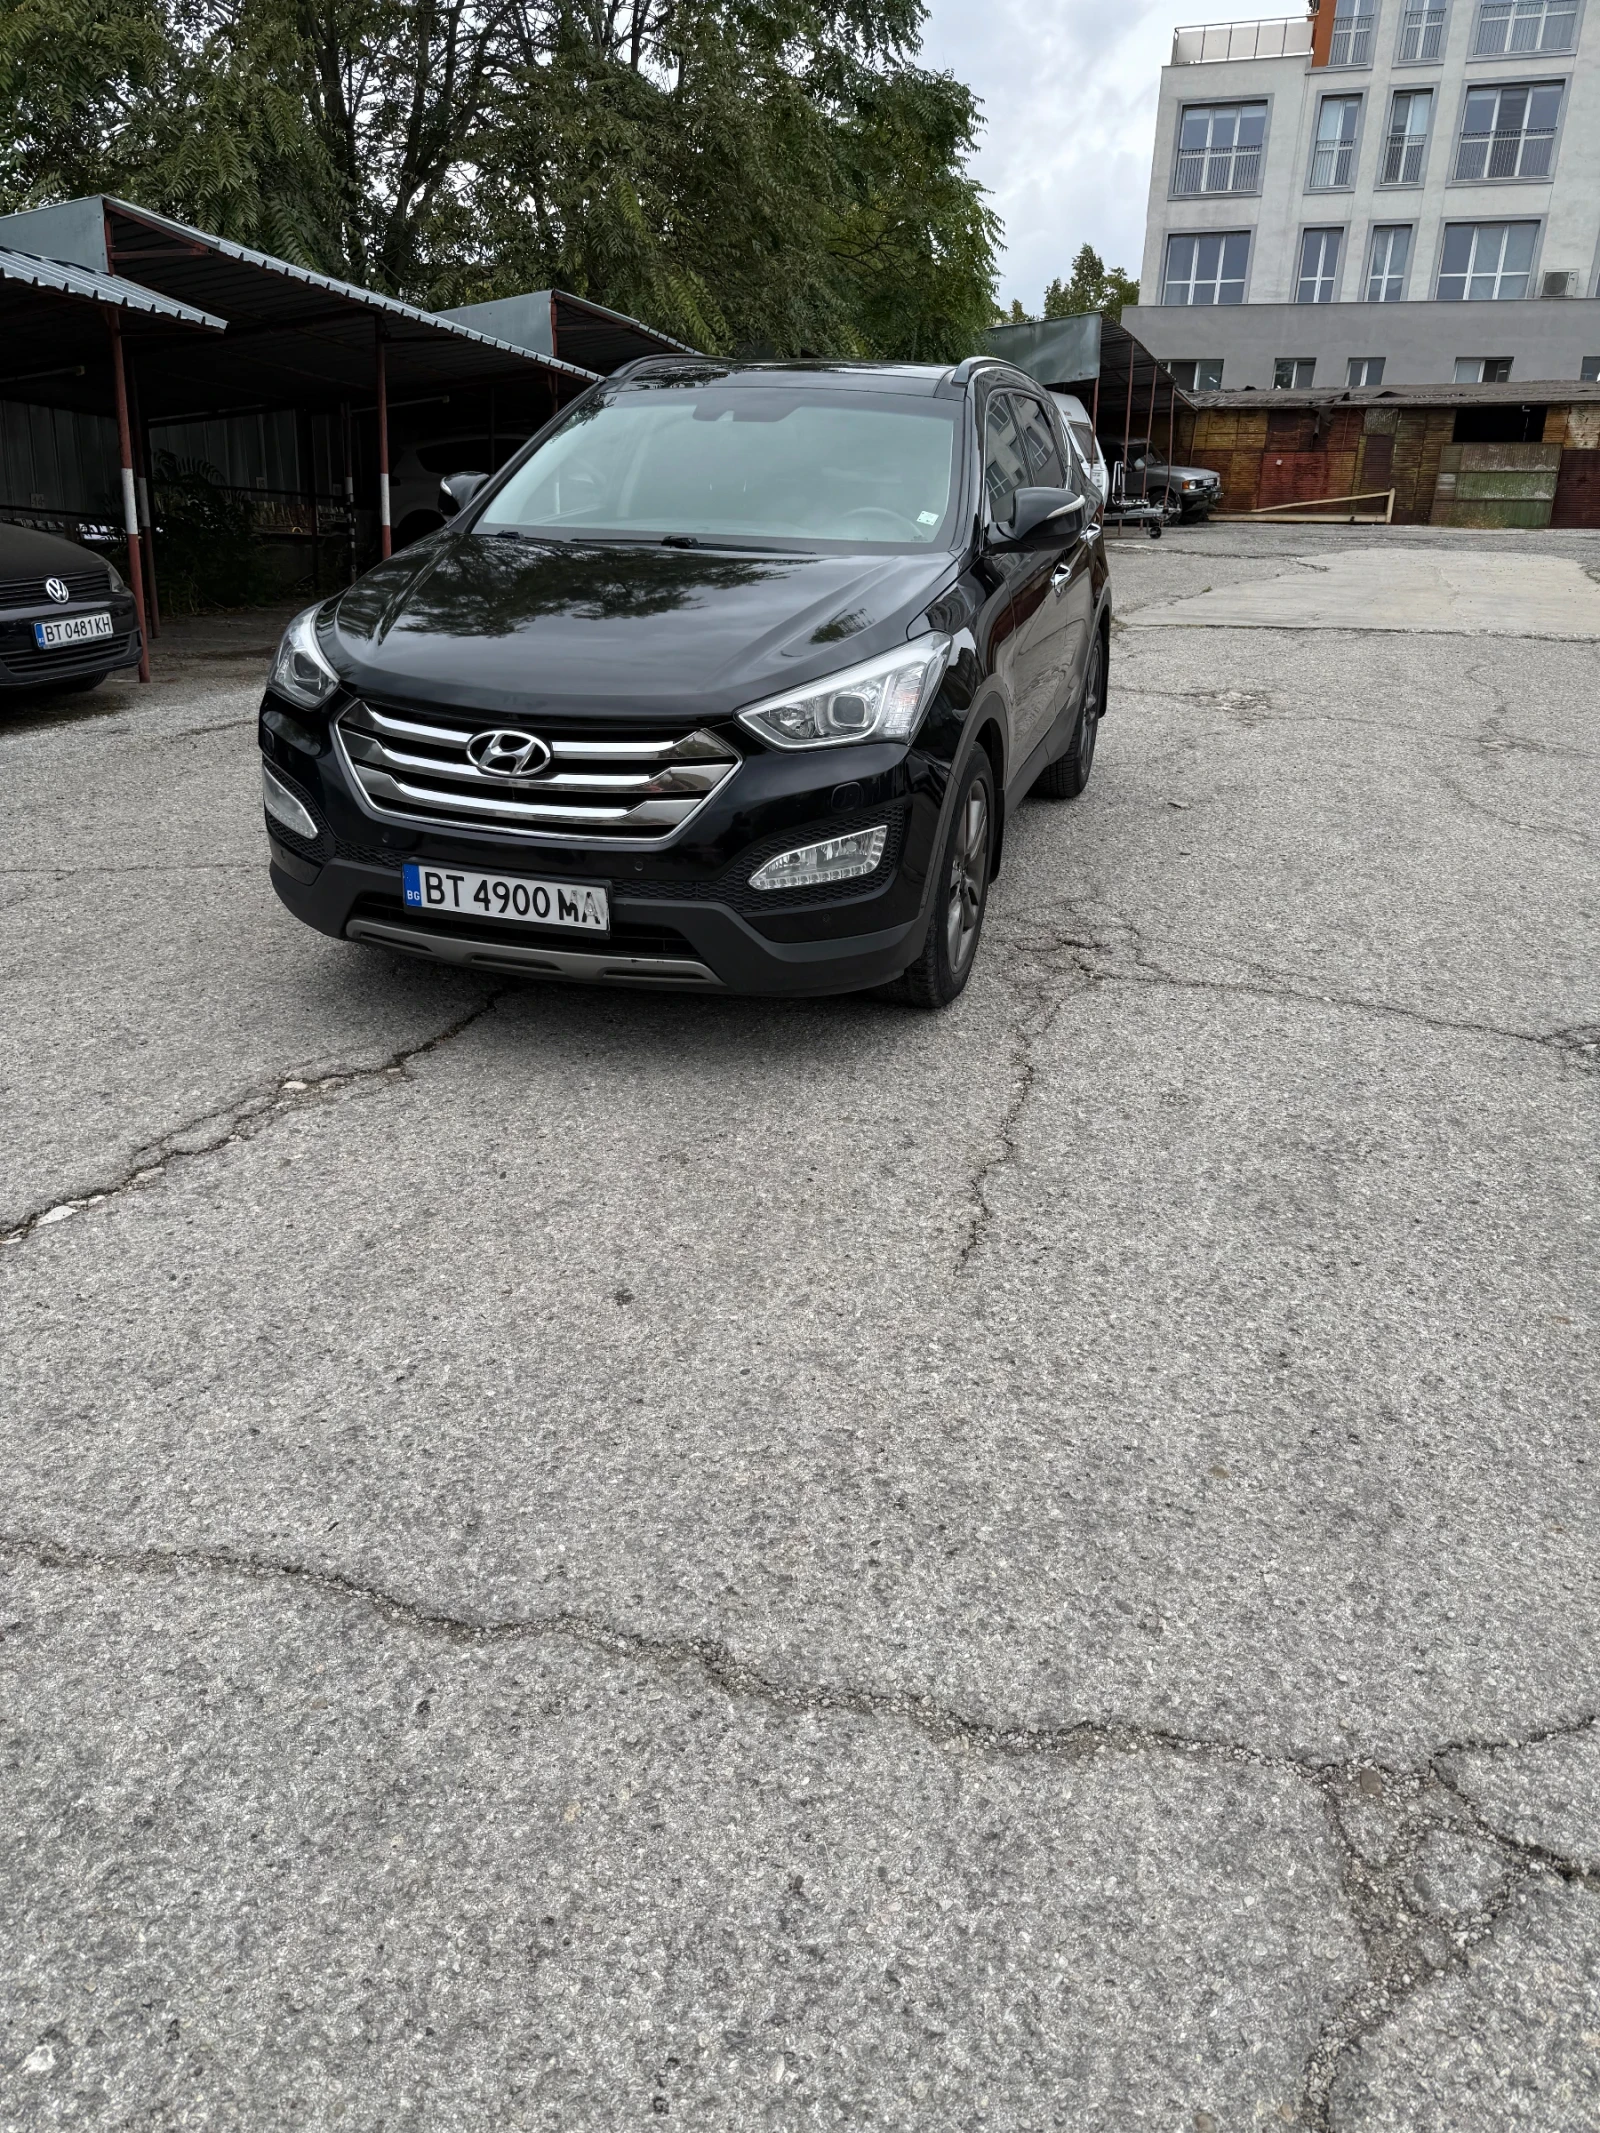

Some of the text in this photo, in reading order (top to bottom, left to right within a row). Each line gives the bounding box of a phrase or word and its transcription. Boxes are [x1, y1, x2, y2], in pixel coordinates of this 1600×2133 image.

[45, 624, 61, 642] BT
[65, 619, 94, 638] 0481
[95, 616, 111, 634] KH
[407, 890, 420, 900] BG
[425, 872, 601, 924] BT 4900 MA
